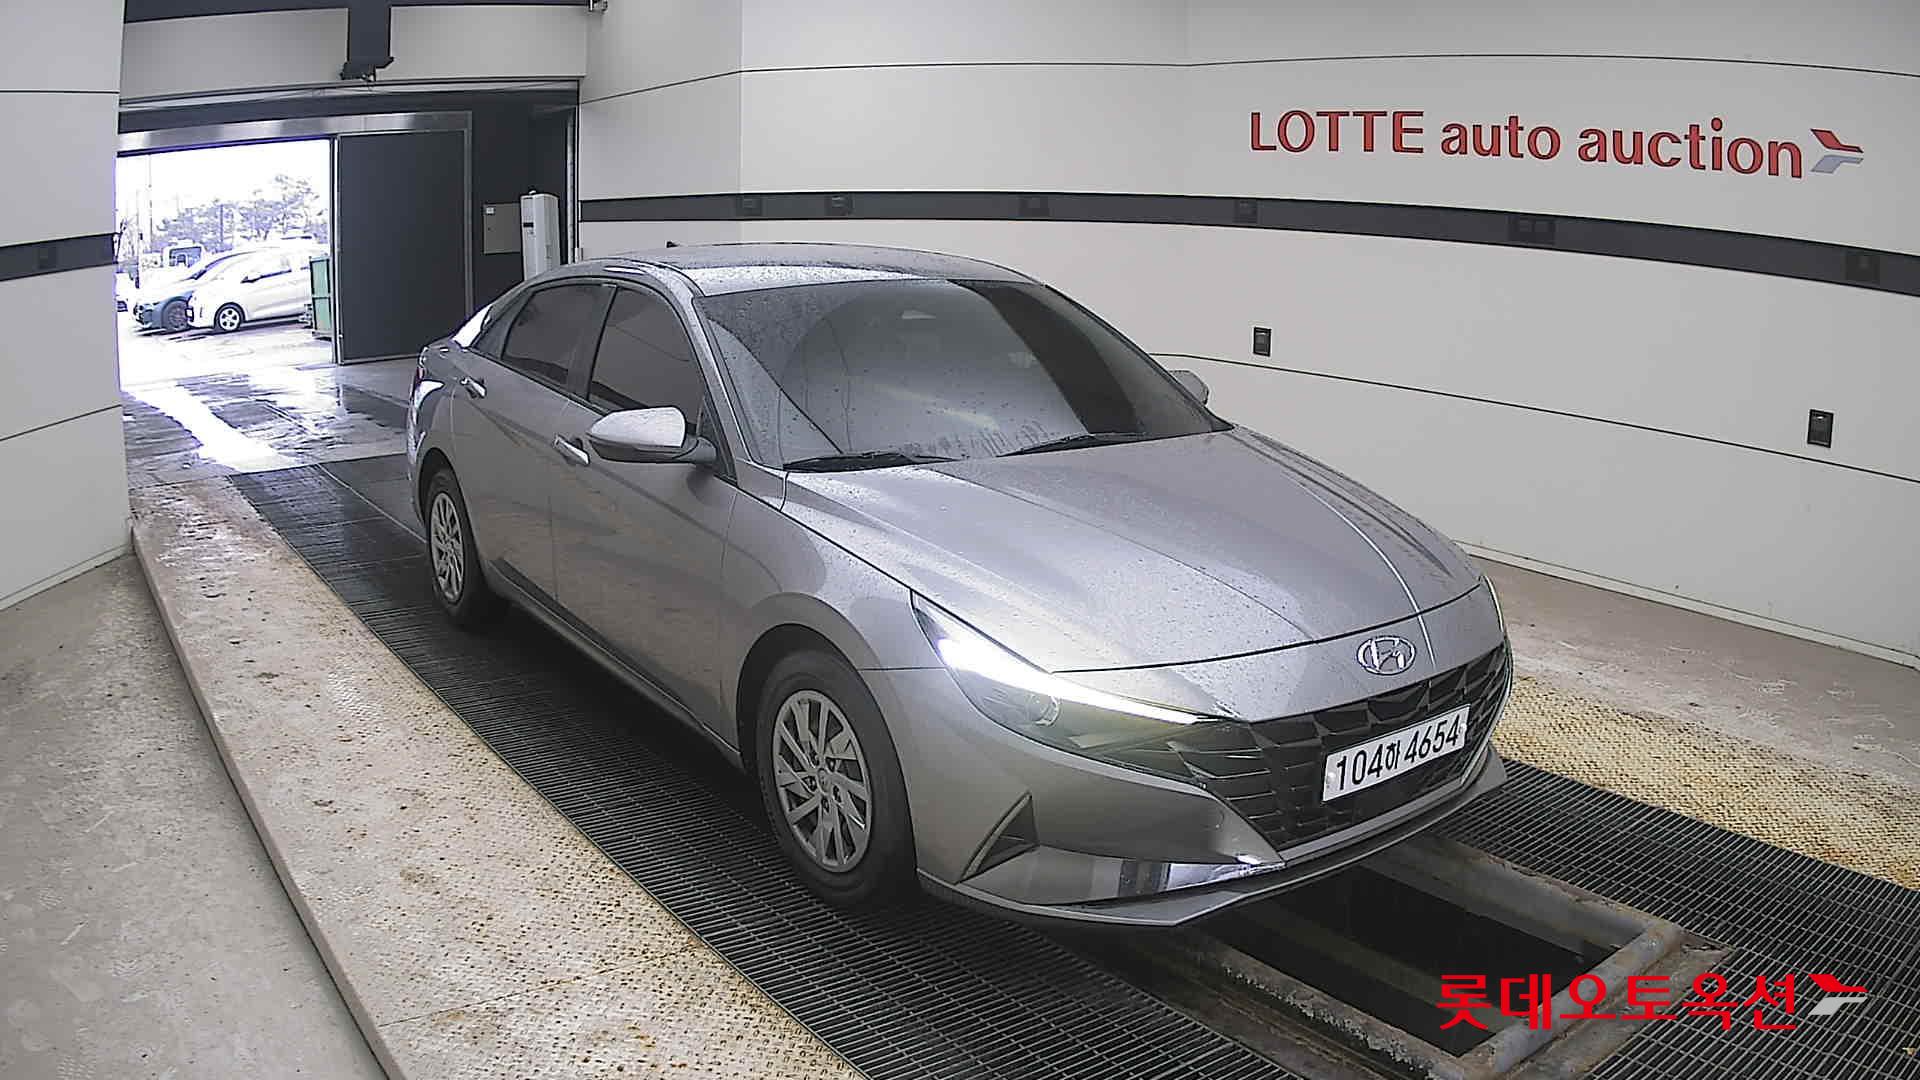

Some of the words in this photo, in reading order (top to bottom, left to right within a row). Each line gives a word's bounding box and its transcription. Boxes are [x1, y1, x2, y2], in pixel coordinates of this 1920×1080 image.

[1250, 110, 1424, 153] LOTTE
[1441, 115, 1561, 159] auto
[1577, 117, 1803, 179] auction
[1336, 739, 1401, 791] 104하
[1404, 714, 1460, 764] 4654
